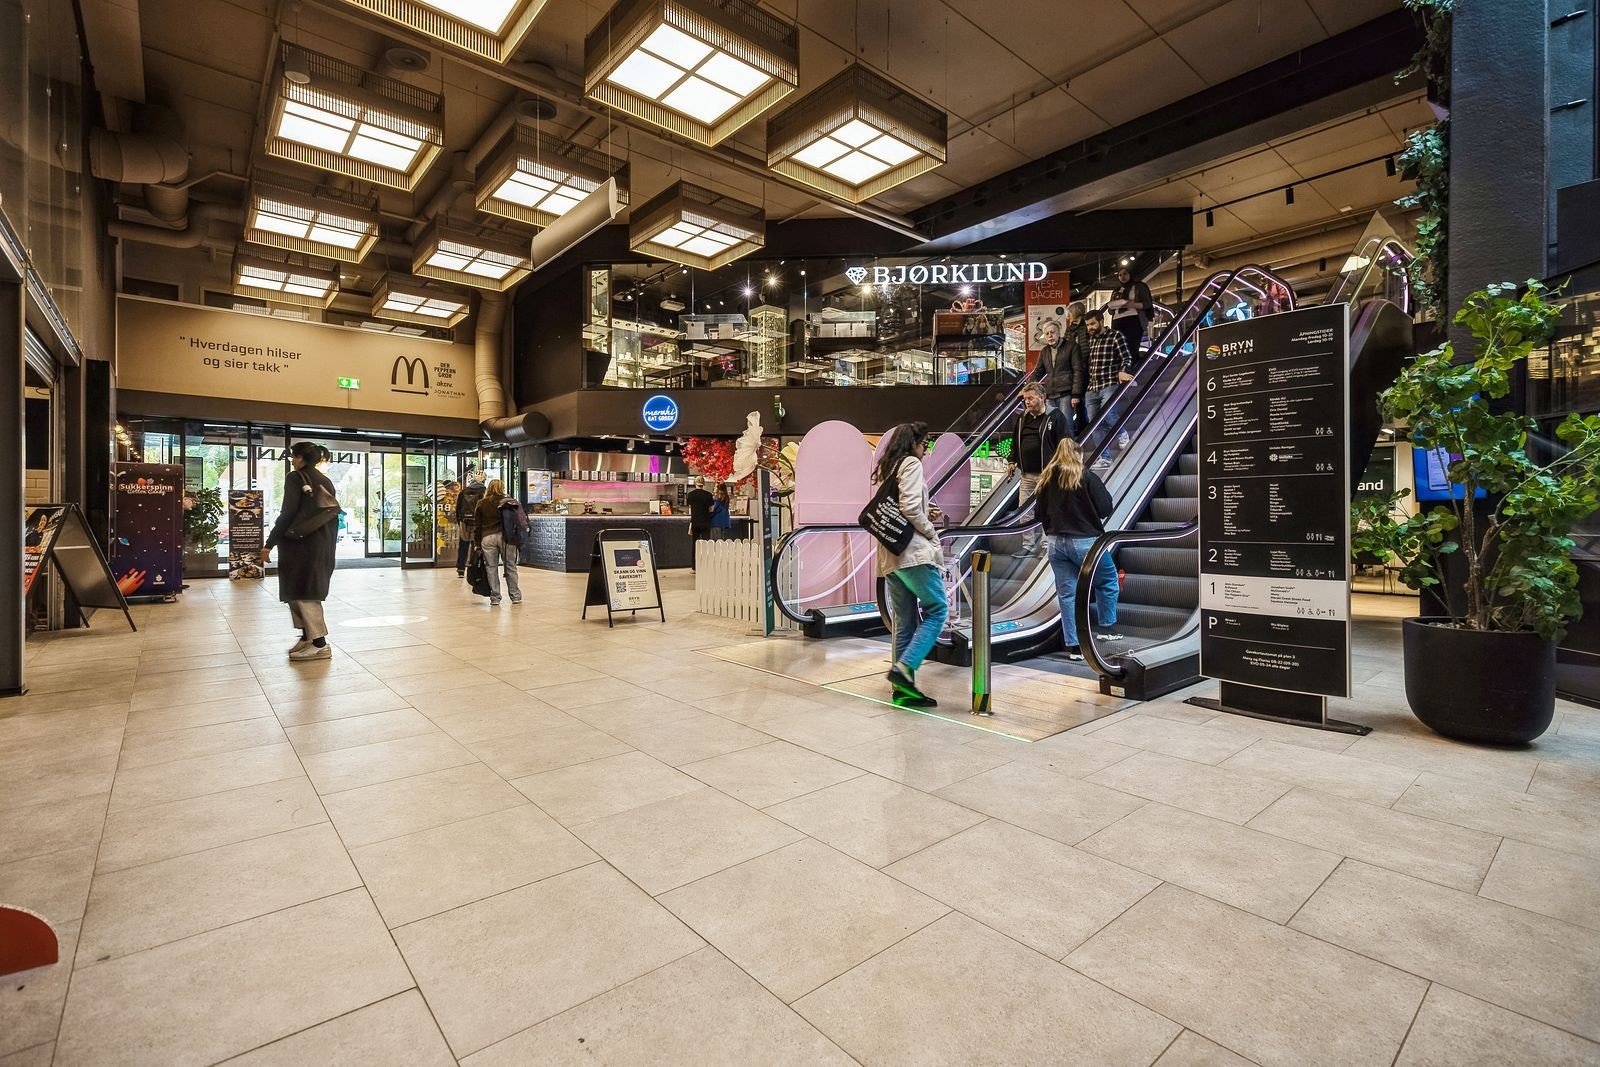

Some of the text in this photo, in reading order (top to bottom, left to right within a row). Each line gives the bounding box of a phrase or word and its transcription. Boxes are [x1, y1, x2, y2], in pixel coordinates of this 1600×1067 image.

[874, 262, 1048, 285] BJØRKLUND
[191, 337, 263, 356] Hverdagen
[267, 347, 302, 360] hilser
[1222, 339, 1254, 352] BRYN
[1223, 348, 1254, 357] SENTER
[203, 357, 220, 369] og
[224, 358, 249, 369] sier
[253, 361, 281, 373] takk
[1207, 377, 1217, 392] 6
[434, 389, 465, 397] JONATHAN
[645, 405, 676, 416] meraki
[1207, 405, 1217, 419] 5
[1206, 451, 1217, 465] 4
[120, 483, 173, 494] Sukkerspinn
[1208, 485, 1217, 500] 3
[1208, 549, 1218, 563] 2
[1210, 582, 1215, 595] 1
[1209, 616, 1218, 629] P
